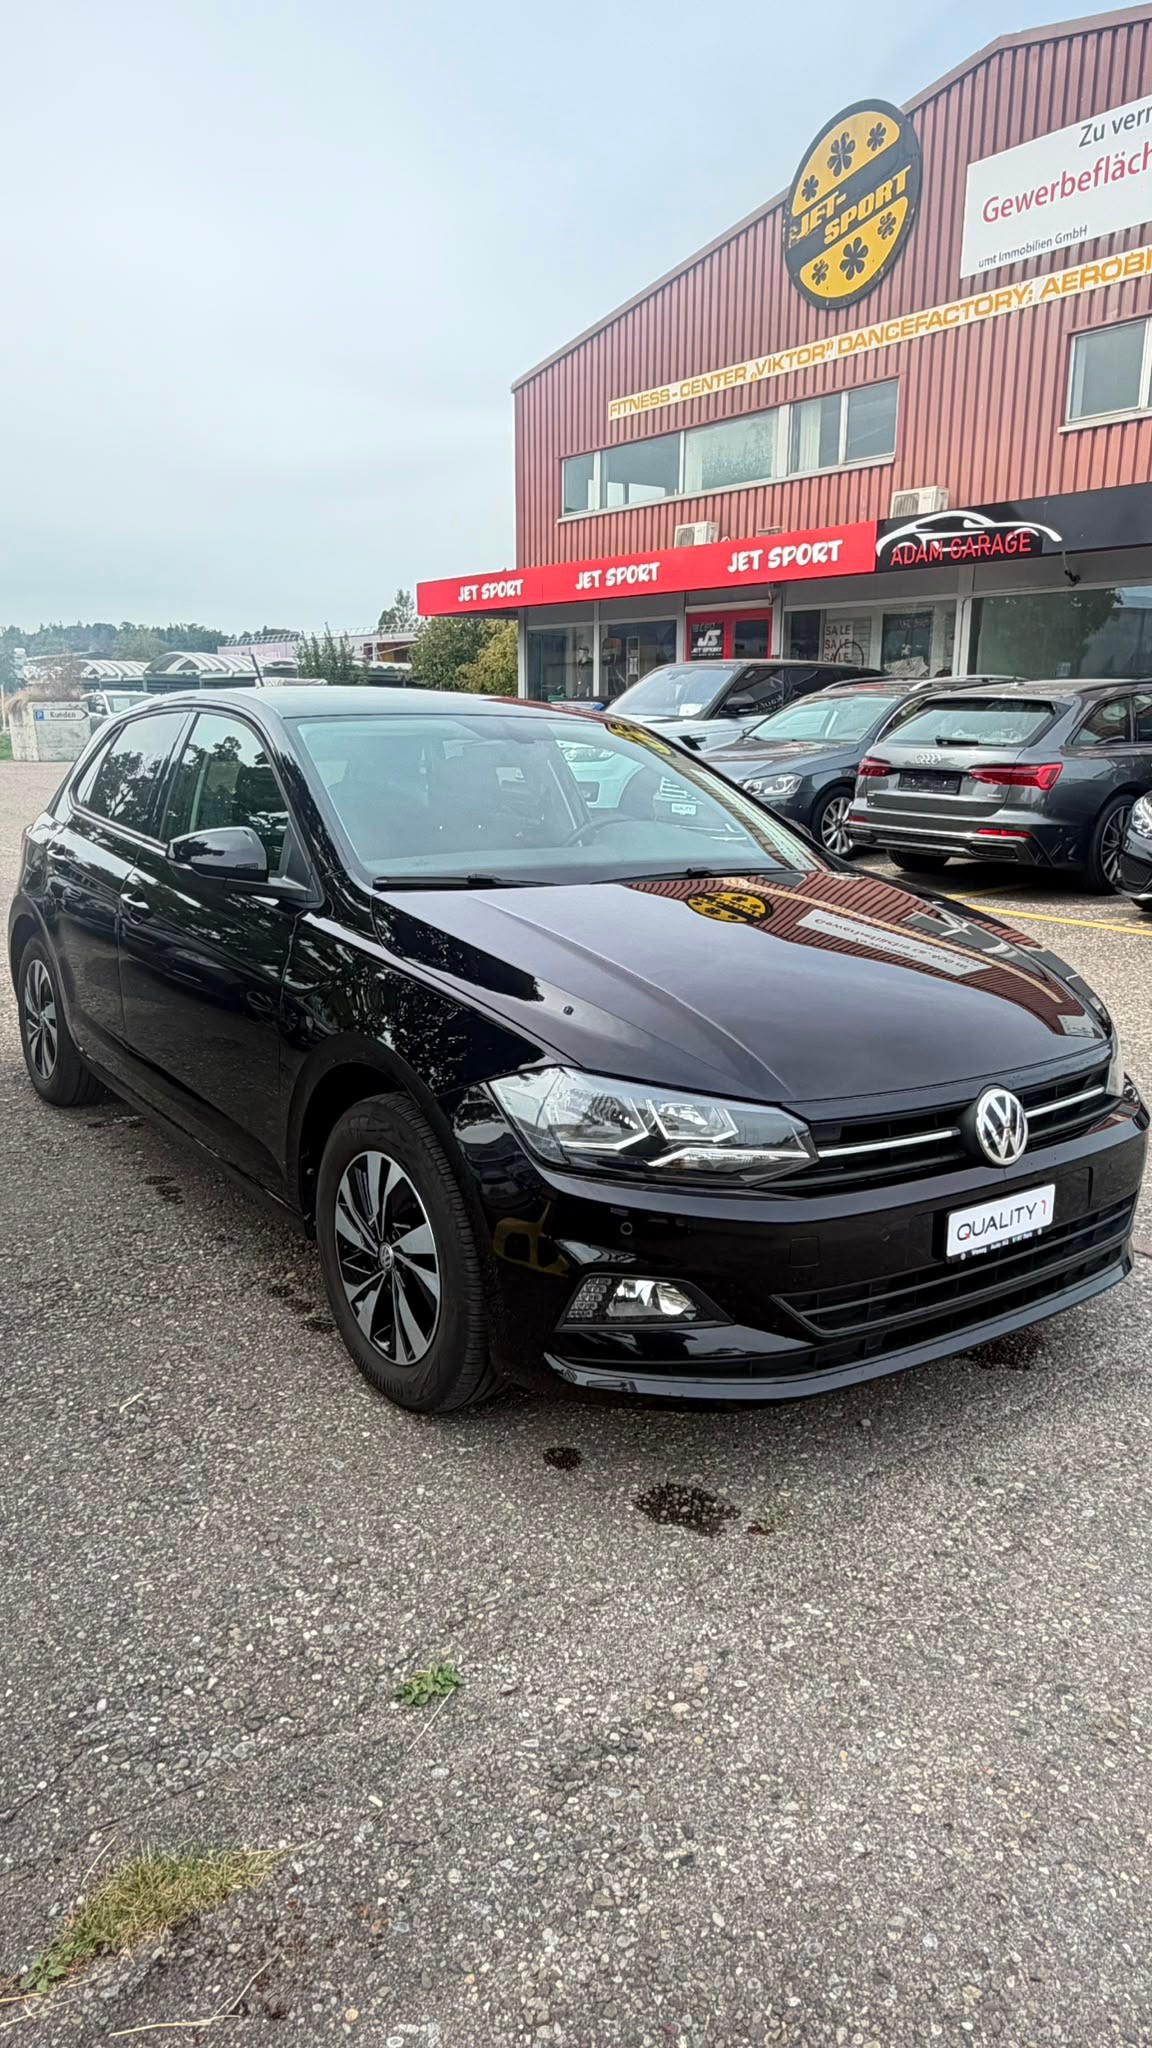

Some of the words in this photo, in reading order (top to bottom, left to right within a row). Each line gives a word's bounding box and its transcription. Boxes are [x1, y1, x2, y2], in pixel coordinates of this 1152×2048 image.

[1079, 123, 1105, 148] Zu
[824, 164, 912, 245] SPORT
[978, 255, 997, 268] umt
[999, 237, 1053, 263] Immobilien
[1055, 225, 1088, 245] GmbH
[727, 549, 764, 574] JET
[767, 539, 843, 569] SPORT
[890, 540, 944, 566] ADAM
[949, 529, 1032, 560] GARAGE
[457, 583, 480, 603] JET
[481, 578, 524, 600] SPORT
[575, 569, 603, 591] JET
[605, 561, 660, 588] SPORT
[50, 711, 76, 719] Kunden
[957, 1202, 1037, 1241] QUALITY
[1041, 1199, 1047, 1215] 1
